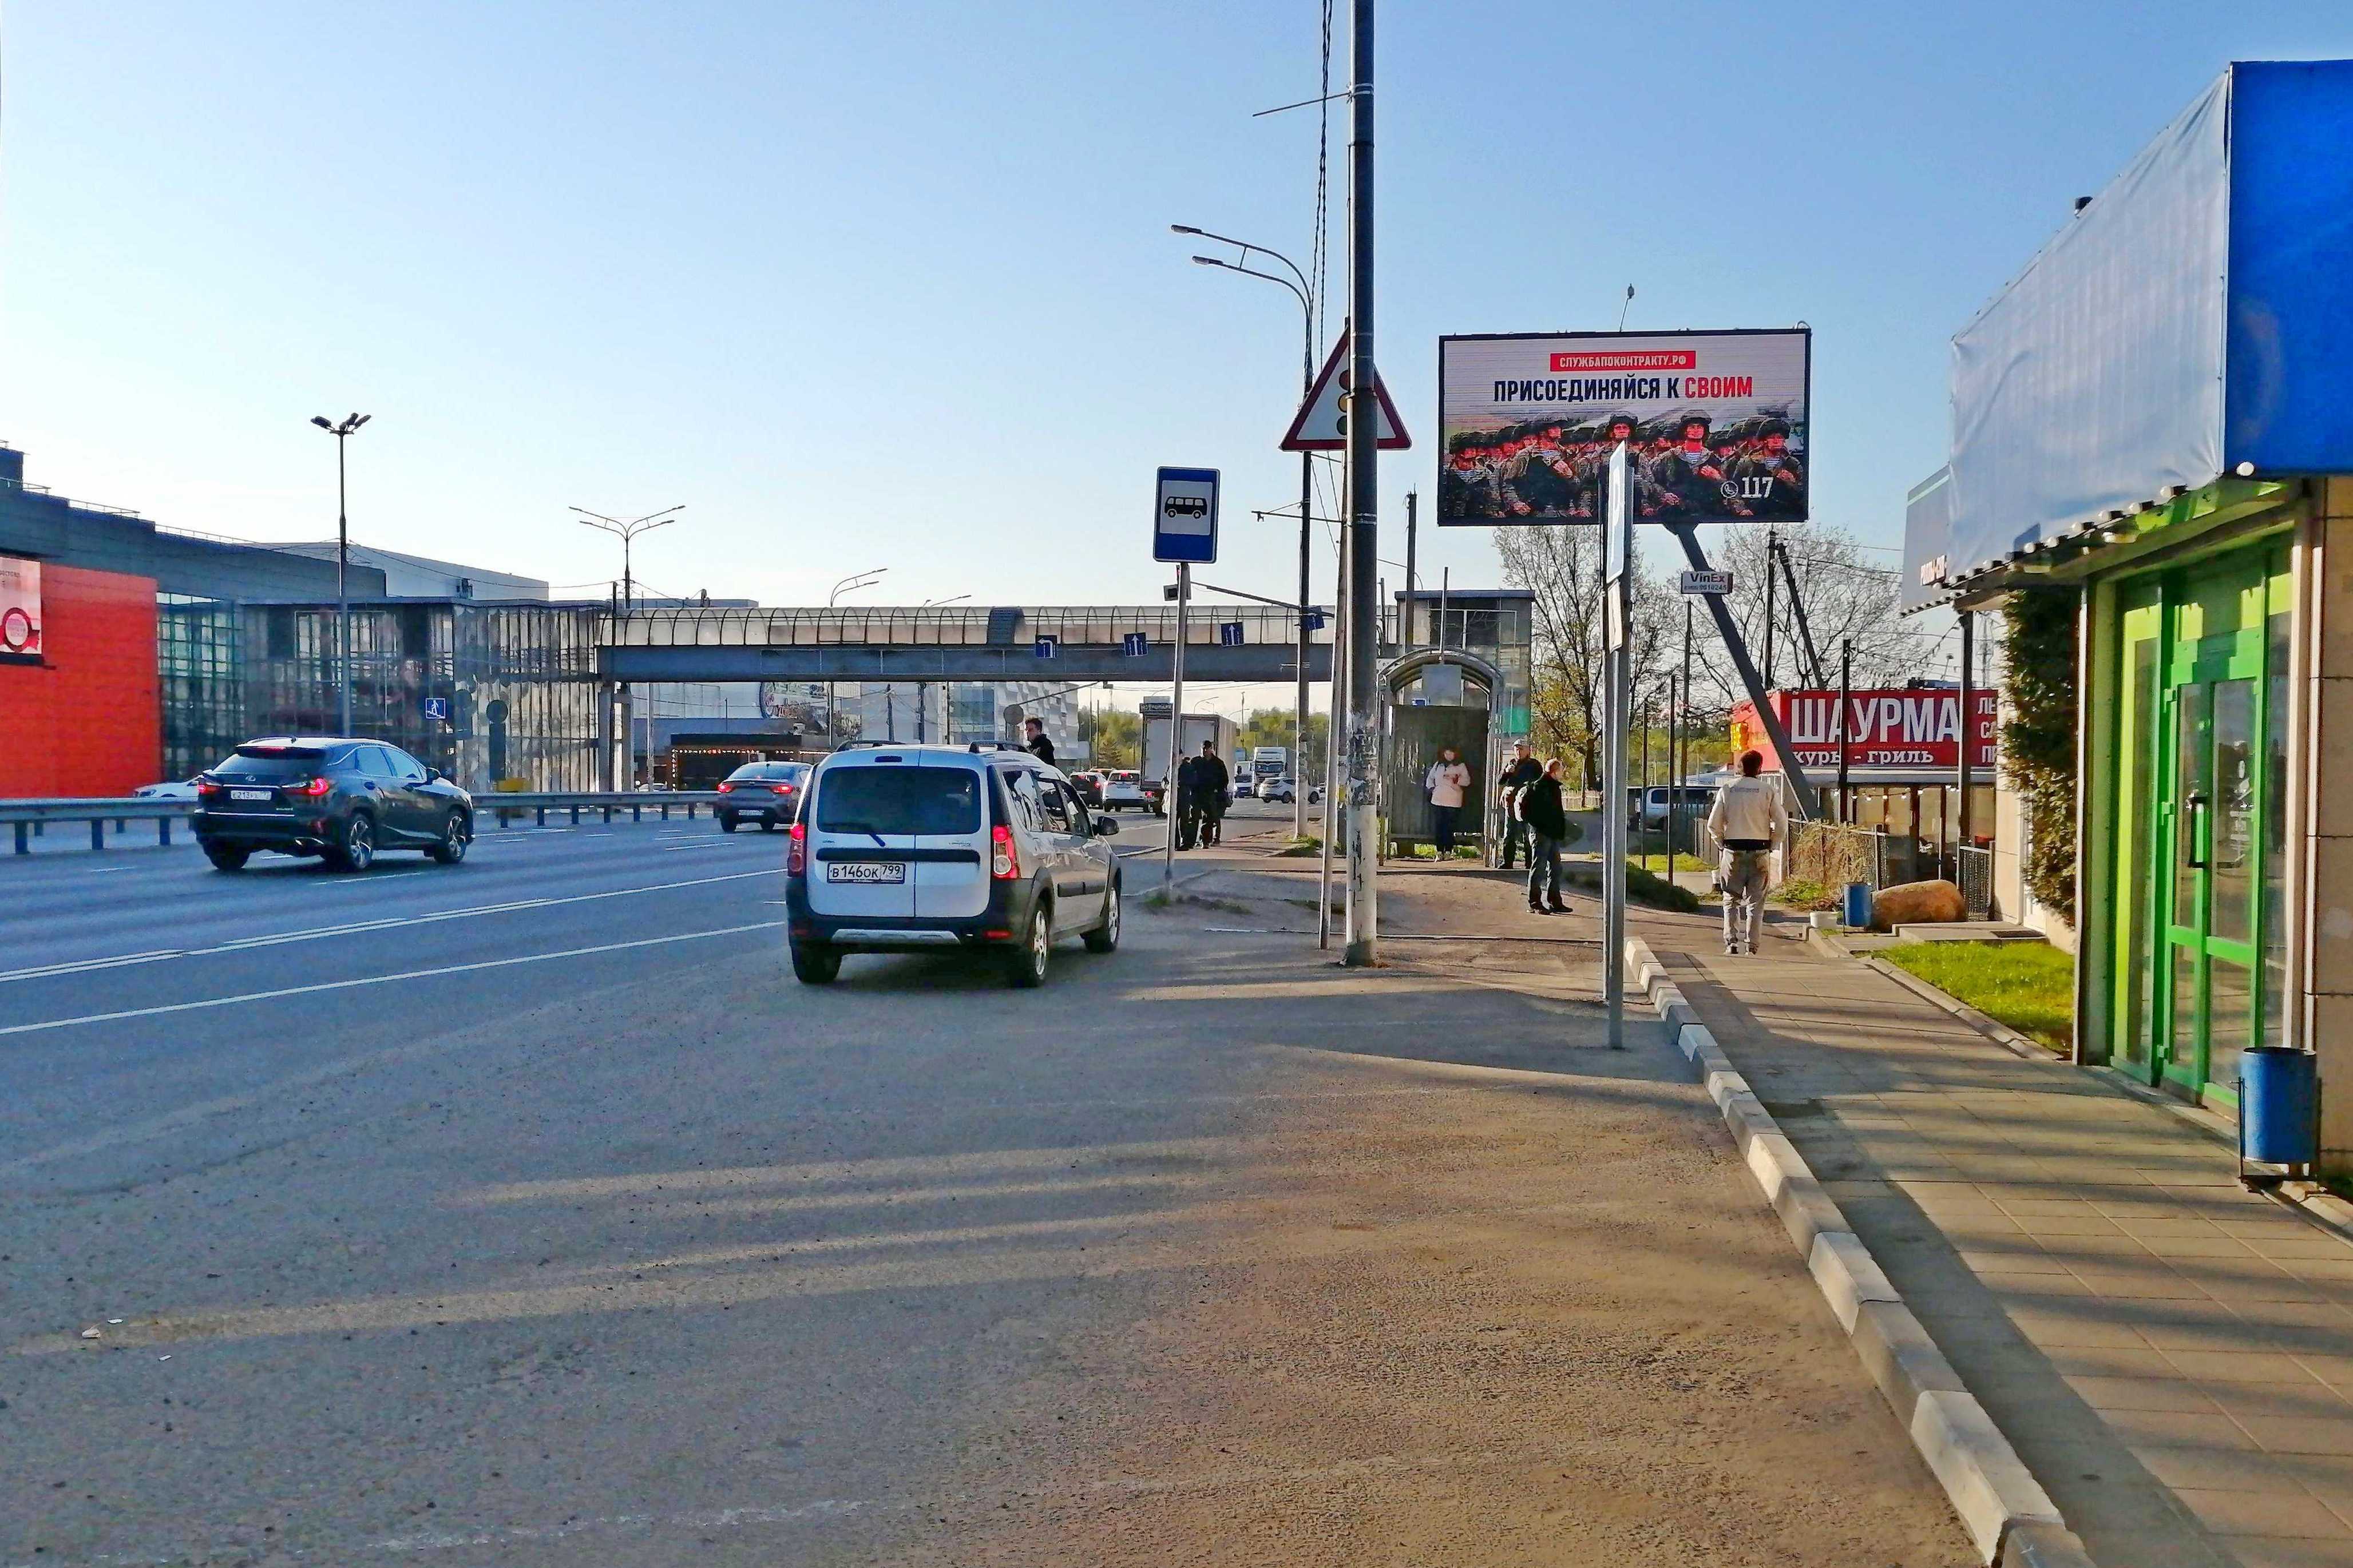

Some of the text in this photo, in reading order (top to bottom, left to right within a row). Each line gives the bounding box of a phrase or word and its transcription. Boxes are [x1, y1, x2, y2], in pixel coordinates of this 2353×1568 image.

[1559, 355, 1686, 368] СЛУЖБАПОКОНТРАКТУ.РФ
[1494, 374, 1753, 402] ПРИСОЕДИНЯЙСЯ К СВОИМ
[1741, 477, 1774, 498] 117
[1690, 573, 1725, 582] VinEx
[1791, 697, 1960, 743] ШАУРМА
[1867, 750, 1934, 765] гриль
